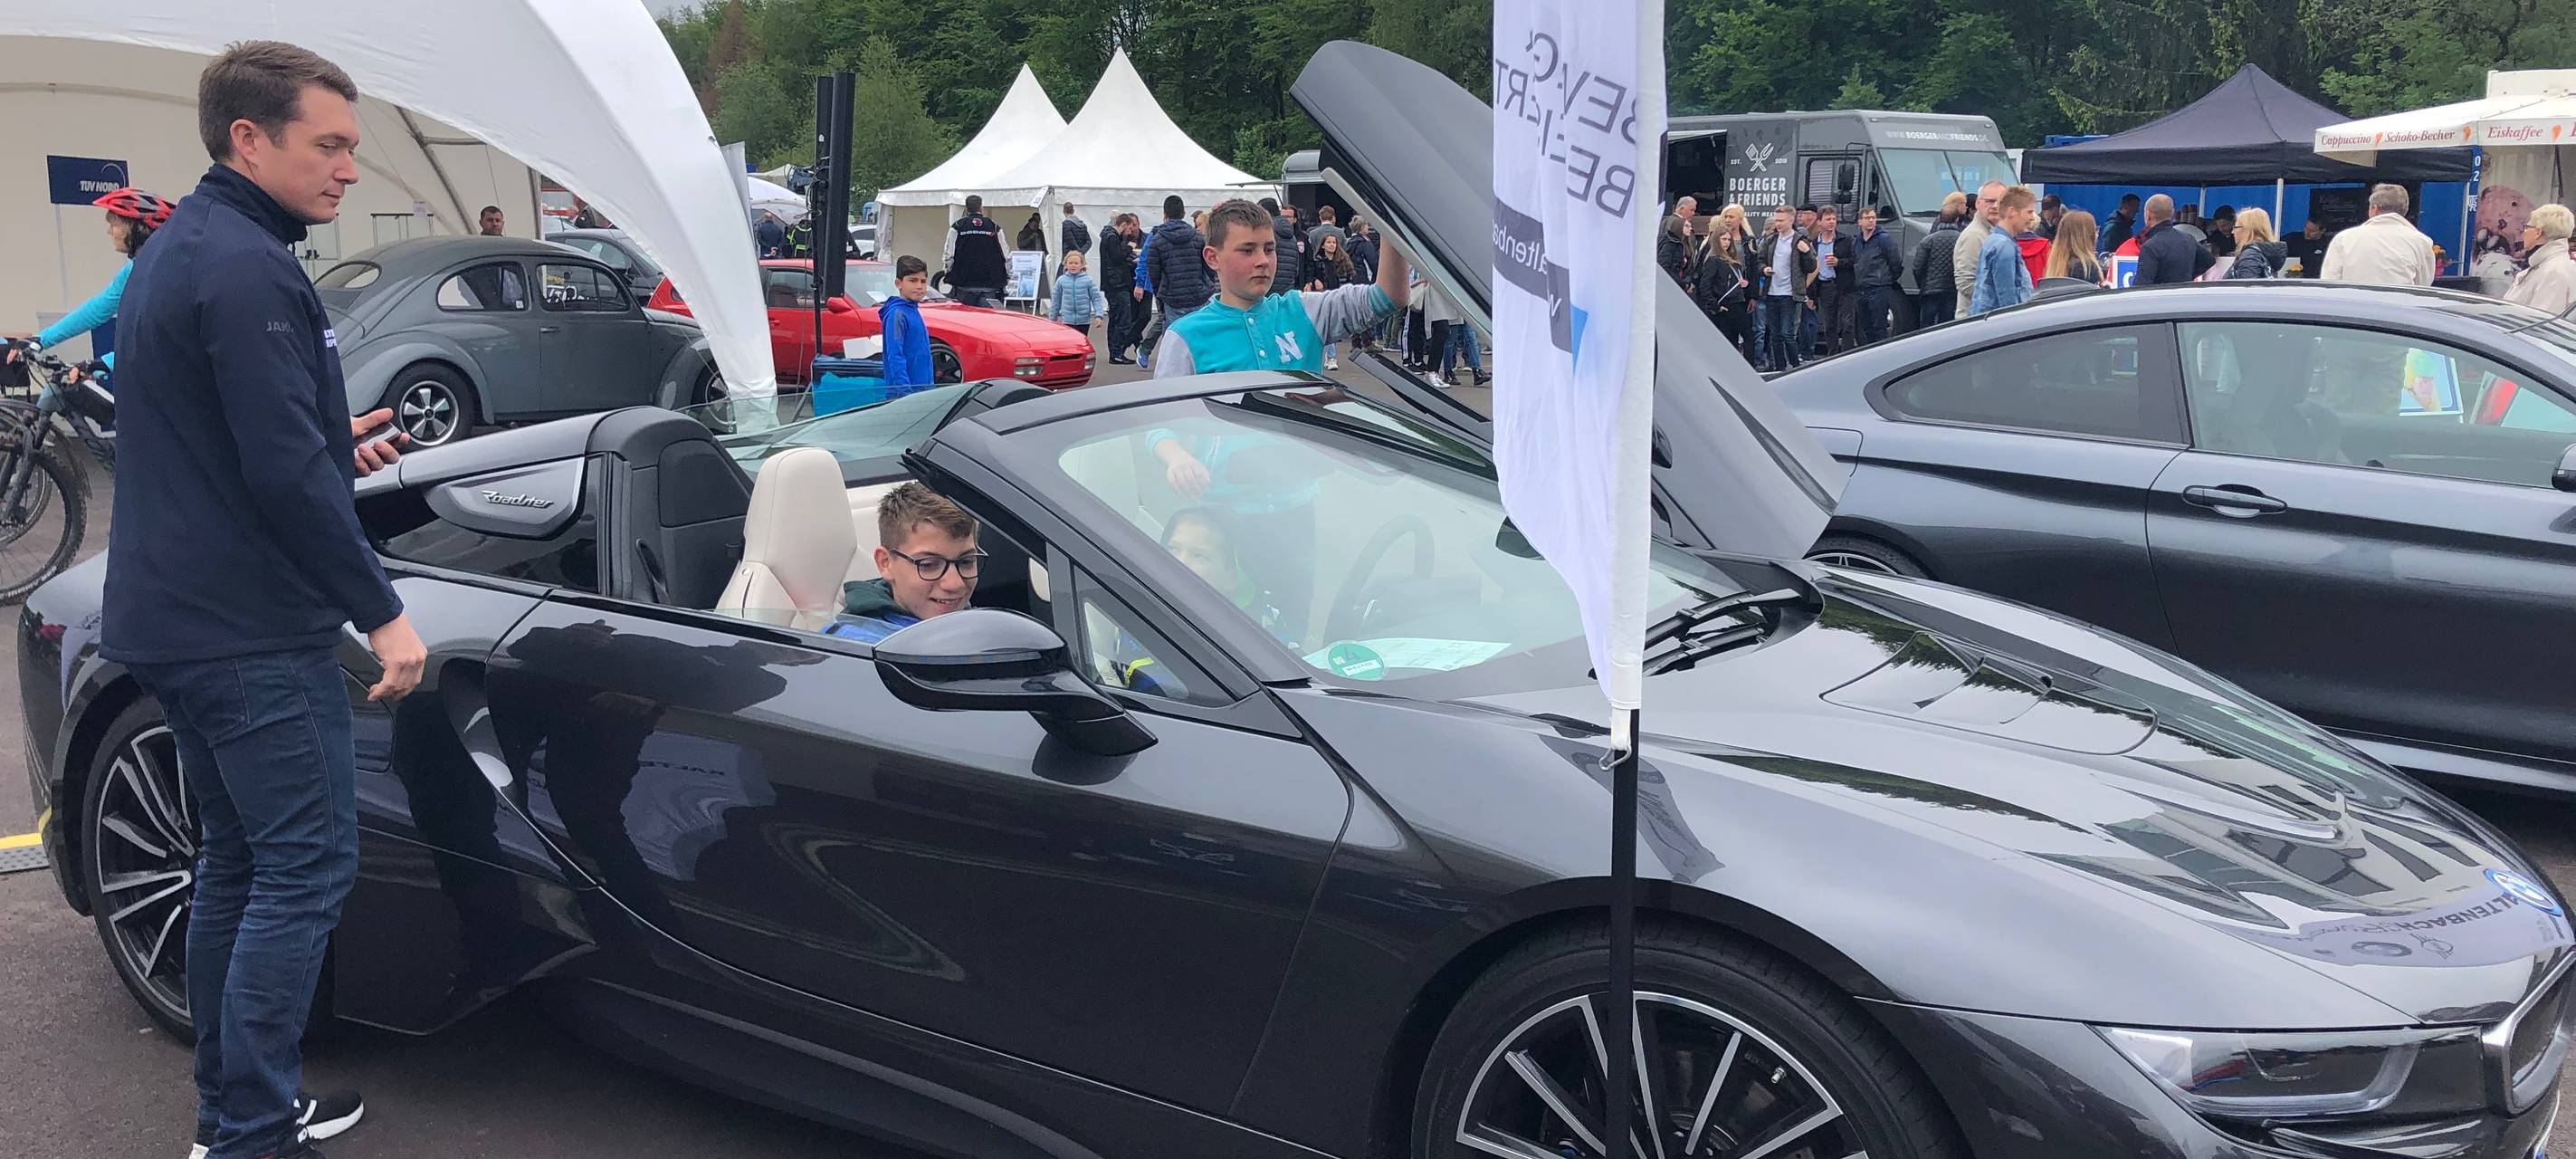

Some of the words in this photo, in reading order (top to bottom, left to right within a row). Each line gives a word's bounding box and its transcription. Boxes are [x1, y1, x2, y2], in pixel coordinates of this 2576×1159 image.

[2321, 133, 2371, 148] Cappuccino
[2385, 129, 2456, 142] Schoko-Becher
[2487, 125, 2543, 141] Eiskaffee
[1729, 177, 1786, 191] BOERGER
[1737, 193, 1786, 206] FRIENDS
[1274, 330, 1303, 363] N
[482, 490, 554, 509] Roadster
